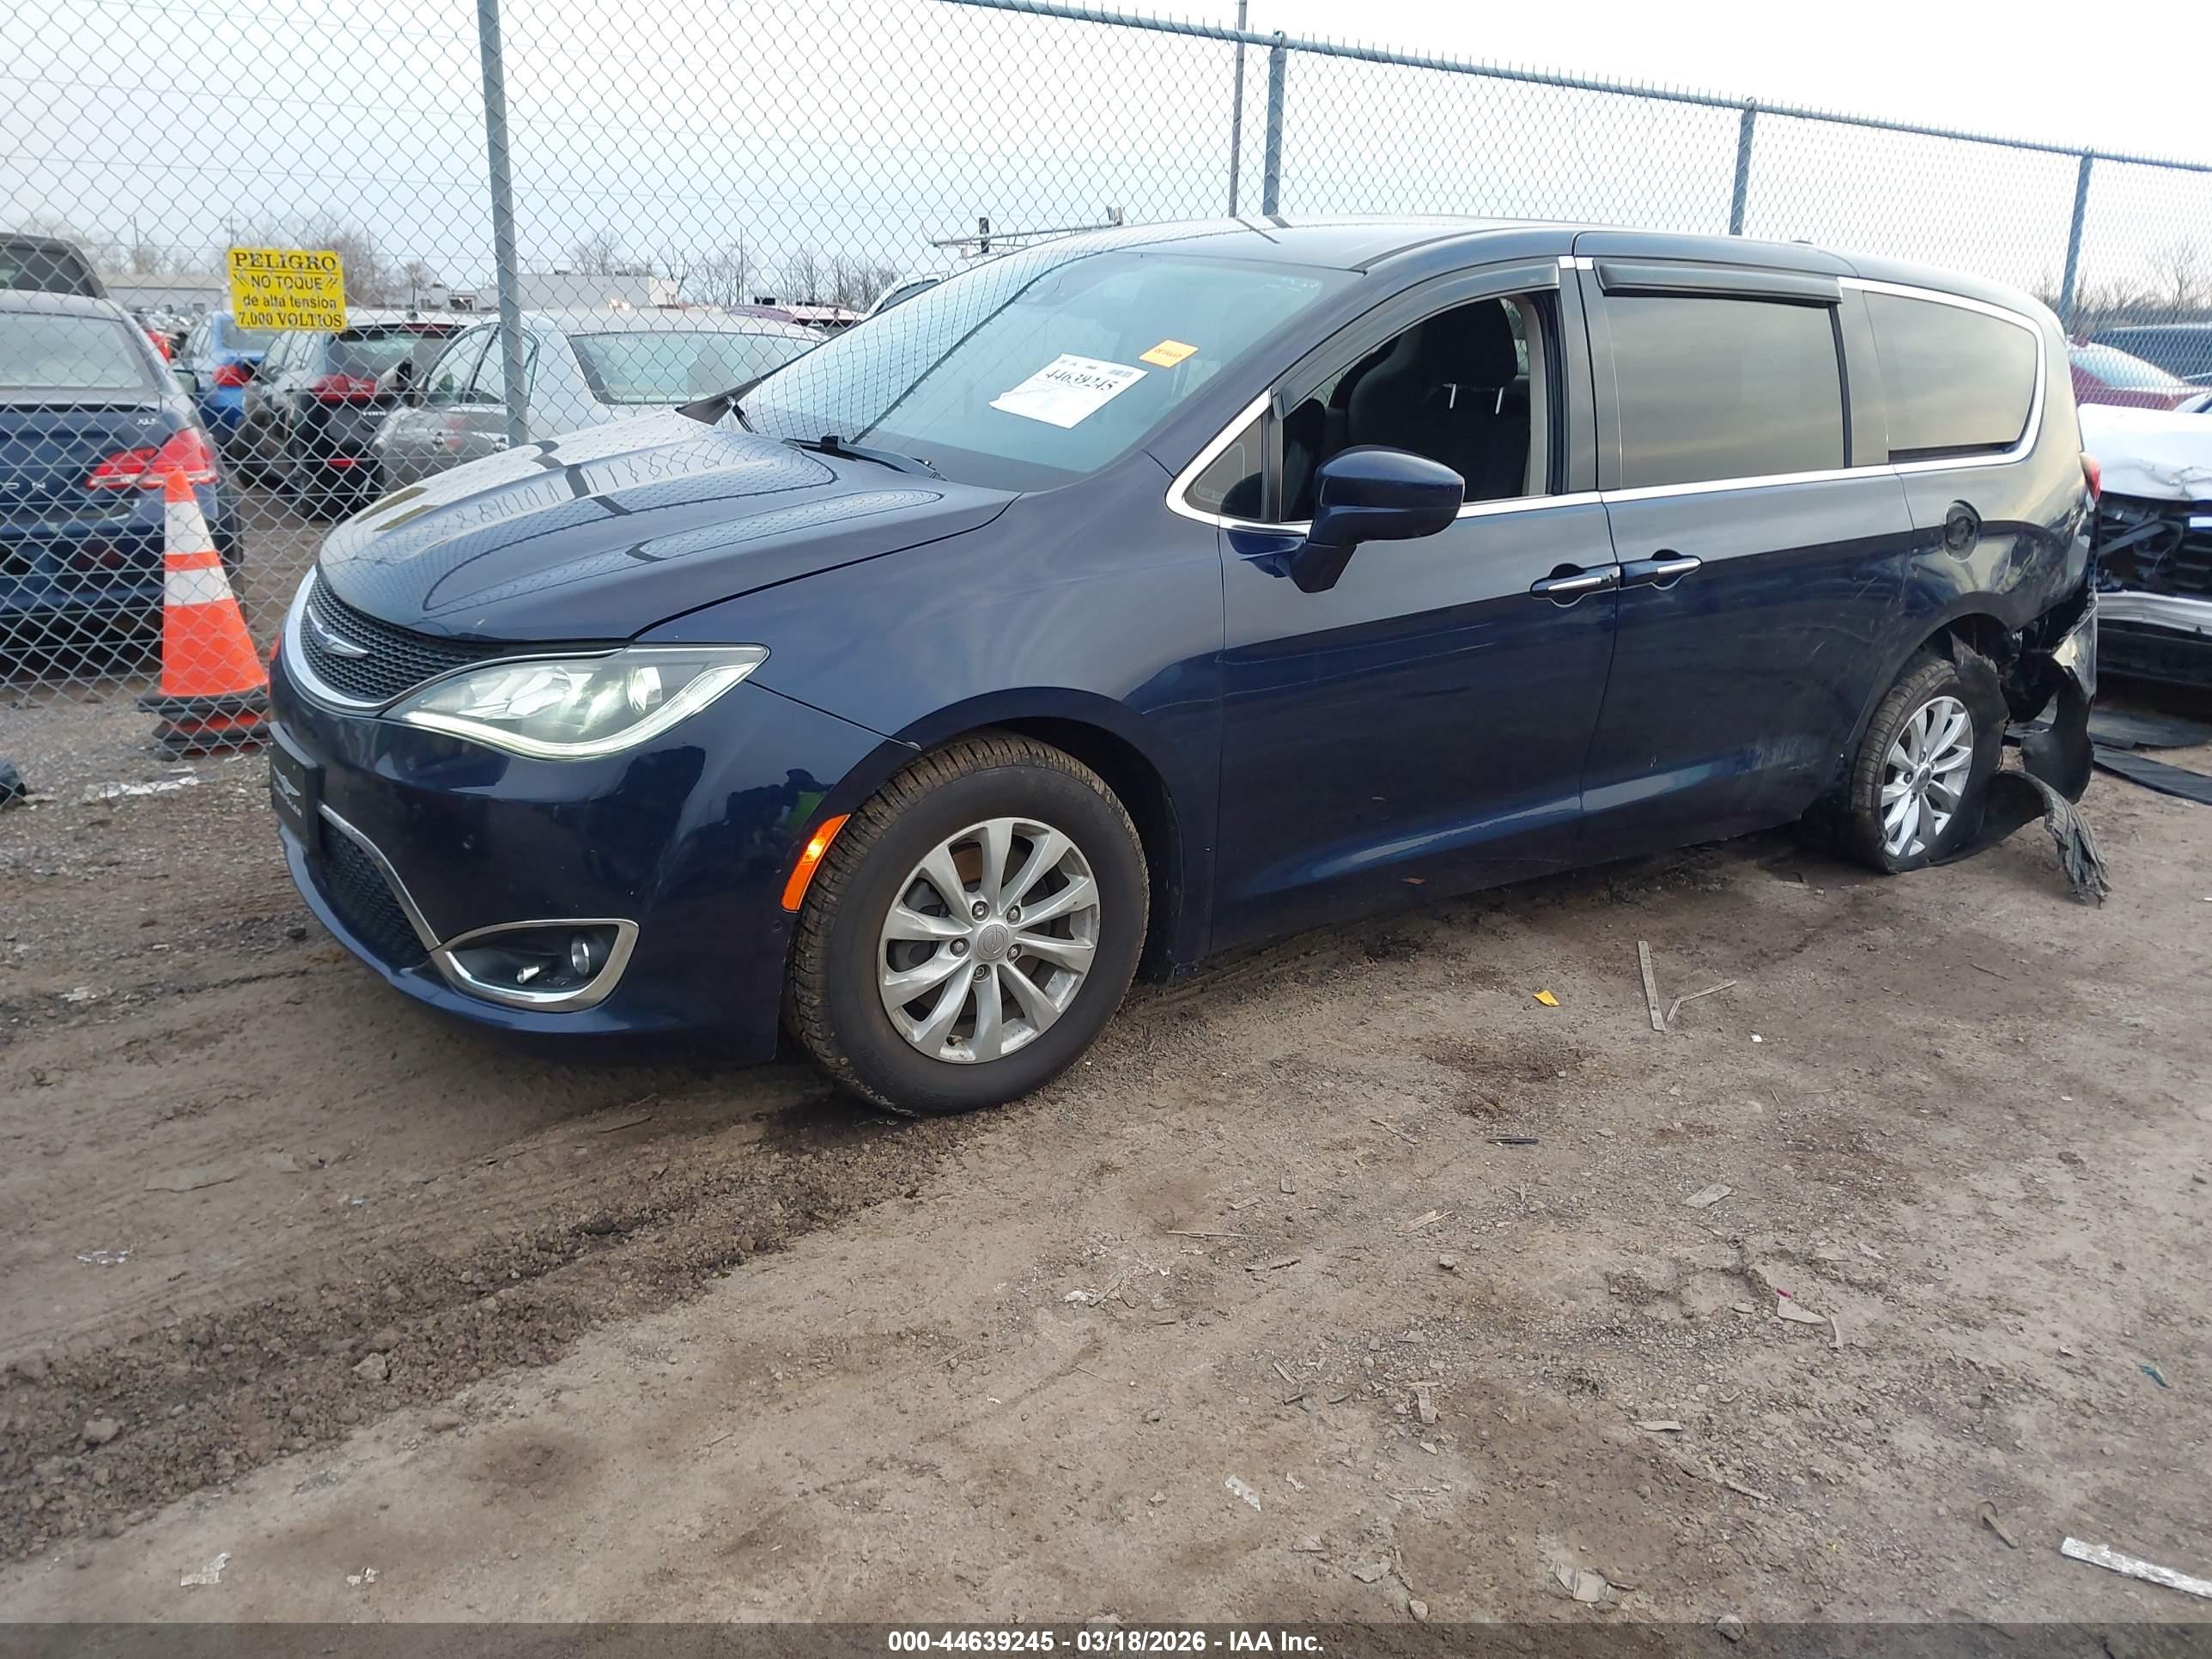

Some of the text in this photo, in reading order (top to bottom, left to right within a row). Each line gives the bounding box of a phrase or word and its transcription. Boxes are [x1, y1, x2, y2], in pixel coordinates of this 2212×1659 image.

[234, 252, 337, 271] PELIGRO
[251, 275, 323, 290] NO TOQUE
[243, 294, 337, 309] de alta tension
[239, 312, 343, 327] 7,000 VOLTIOS
